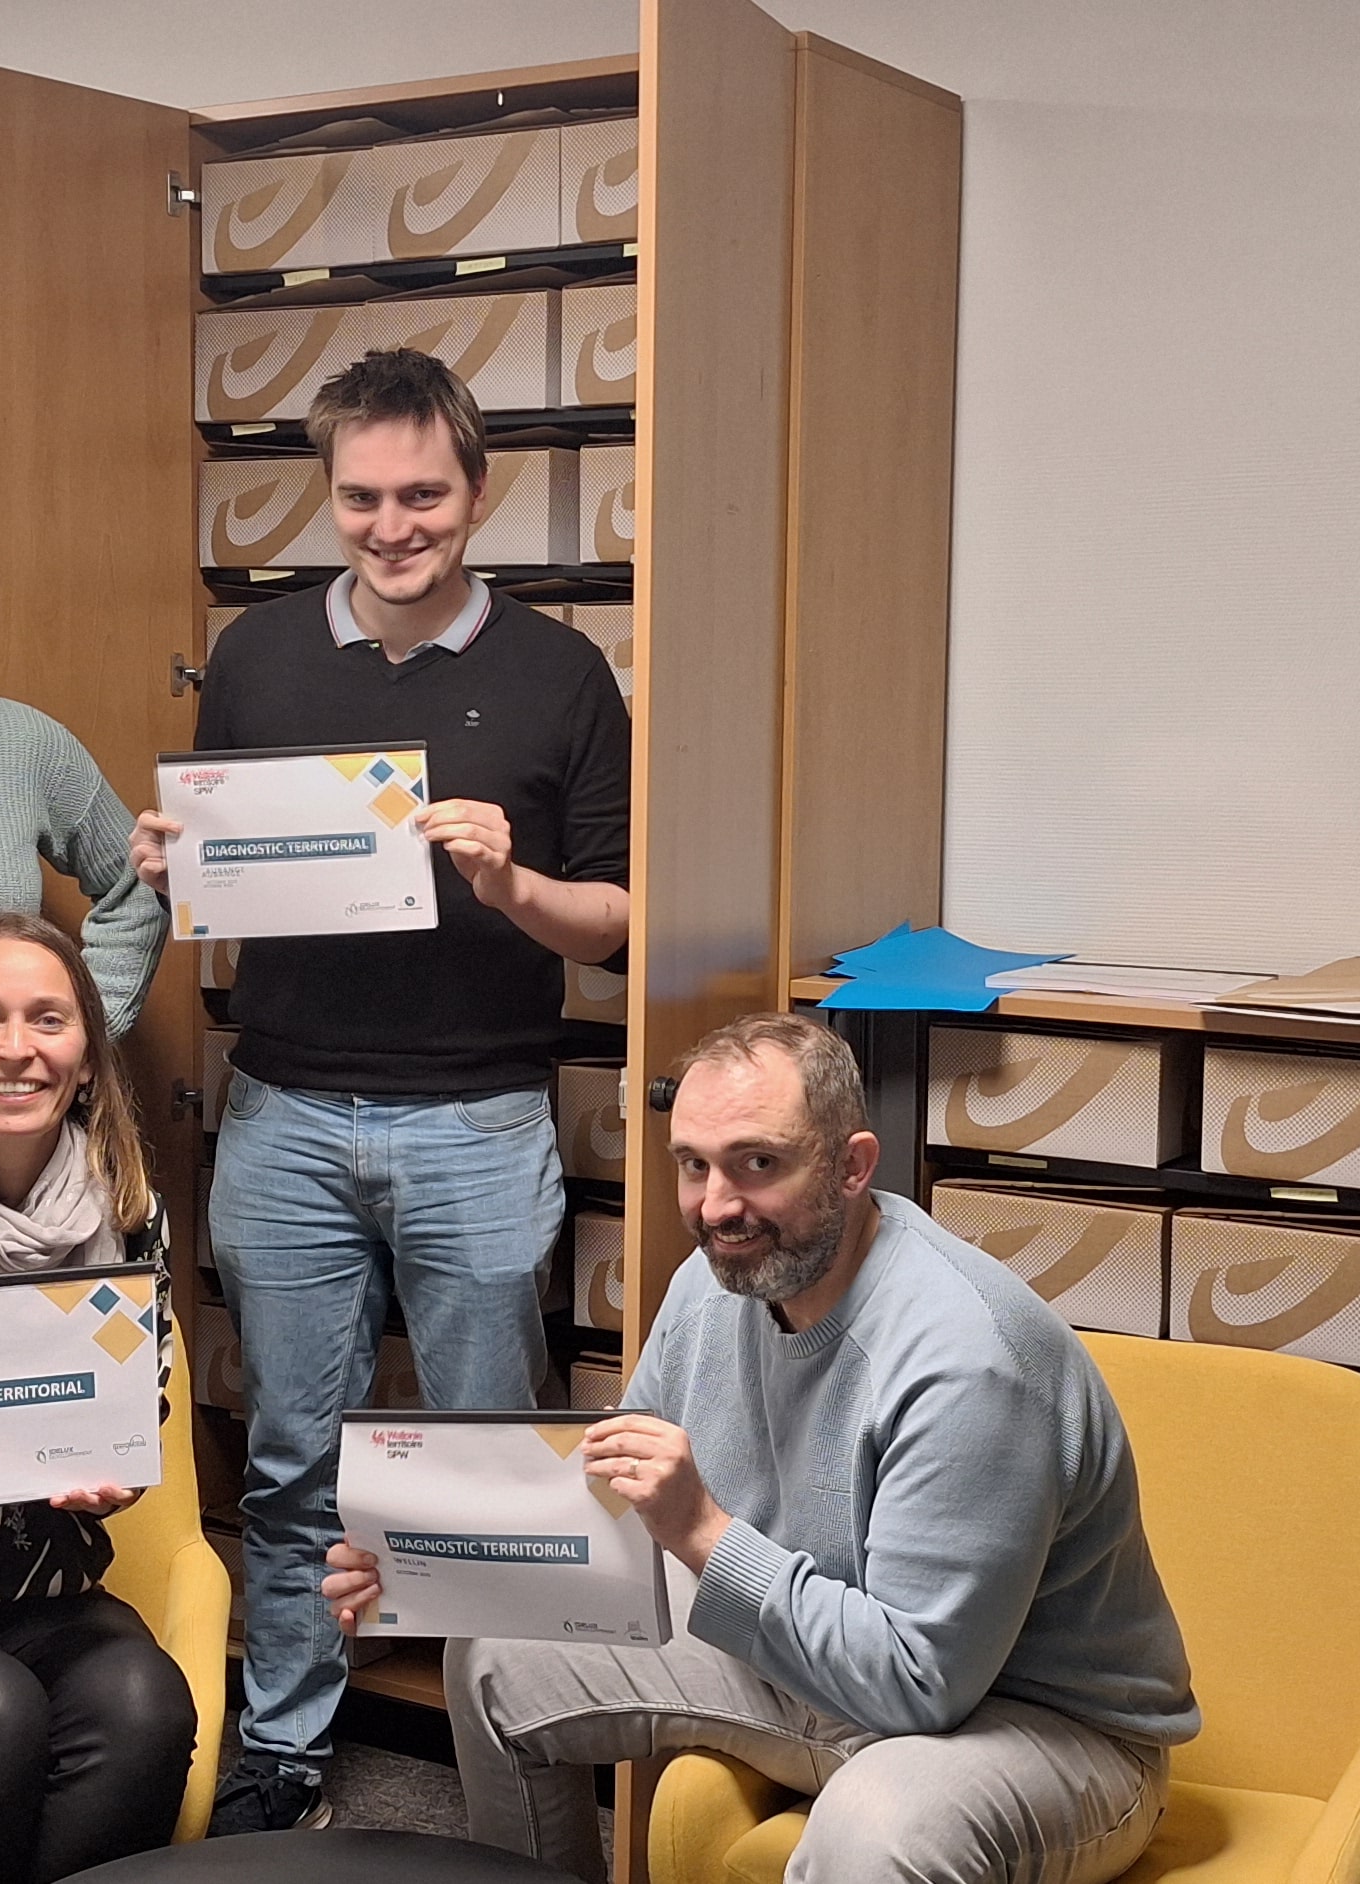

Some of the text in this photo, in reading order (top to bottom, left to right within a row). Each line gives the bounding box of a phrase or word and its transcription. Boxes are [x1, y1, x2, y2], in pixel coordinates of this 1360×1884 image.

[205, 837, 369, 857] DIAGNOSTIC TERRITORIAL
[387, 1450, 409, 1459] SPW
[389, 1537, 579, 1558] DIAGNOSTIC TERRITORIAL
